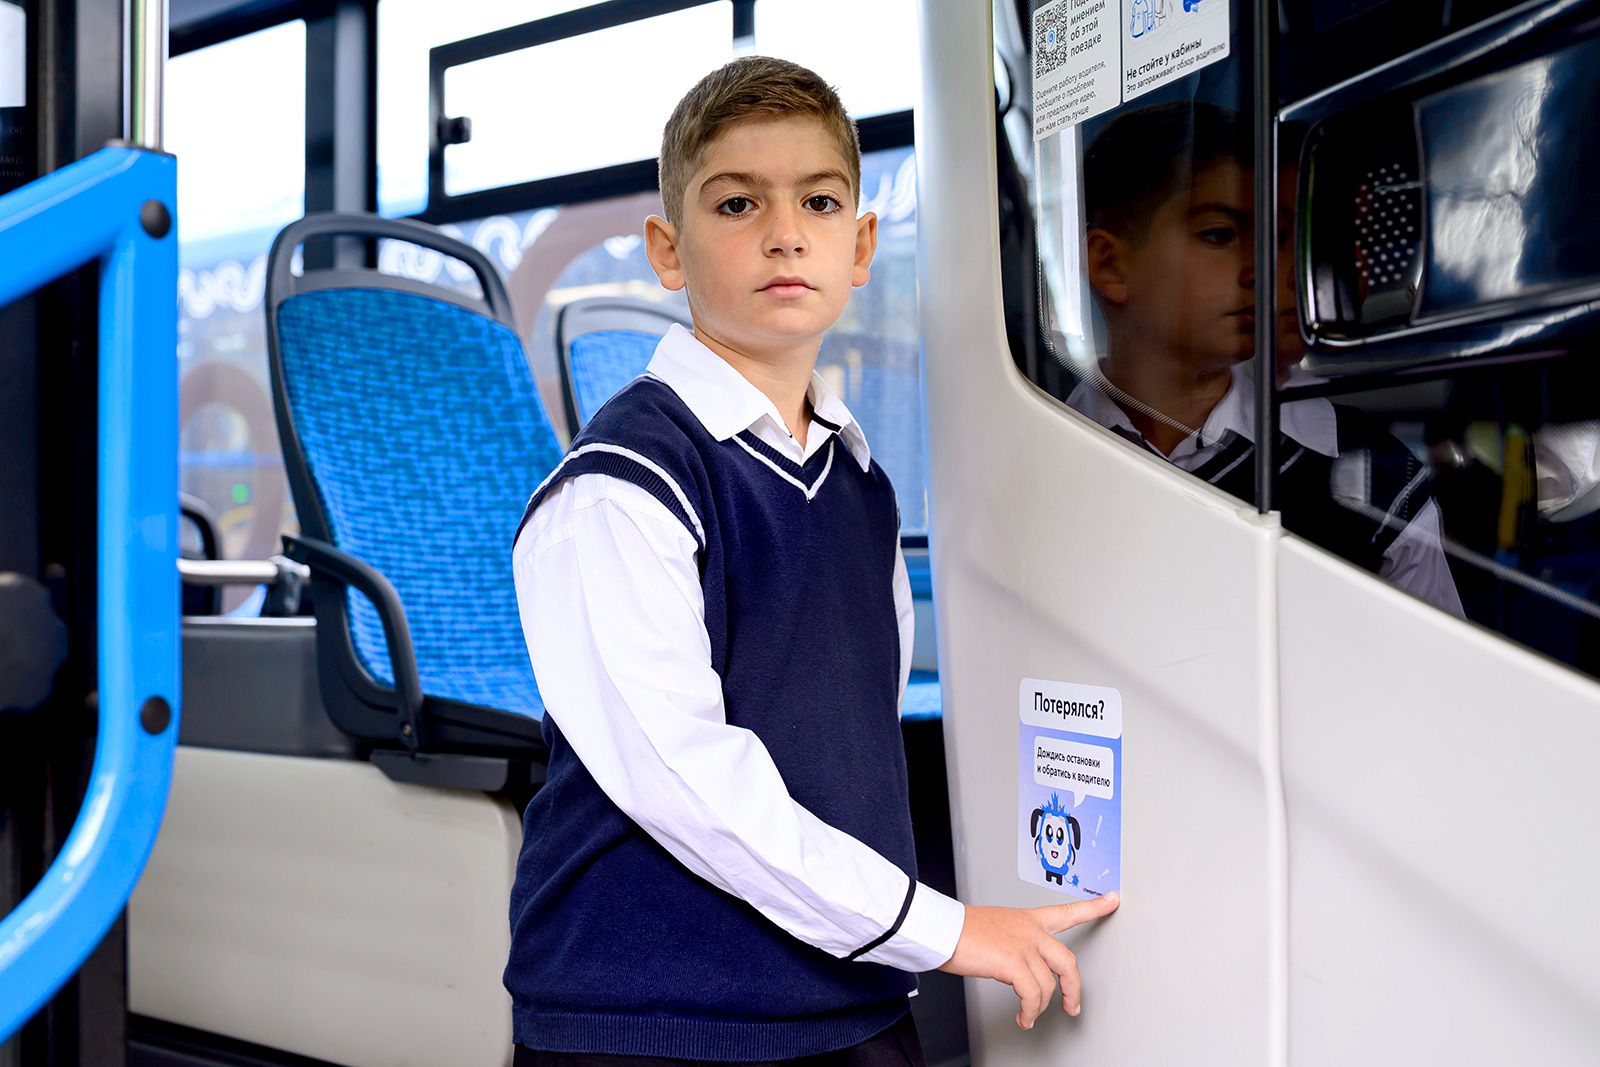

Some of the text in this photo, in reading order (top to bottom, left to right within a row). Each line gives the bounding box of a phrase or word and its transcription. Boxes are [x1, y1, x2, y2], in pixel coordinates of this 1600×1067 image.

[1071, 0, 1088, 10] Под
[1071, 1, 1105, 26] мнением
[1071, 17, 1098, 41] об этой
[1071, 34, 1101, 56] поездке
[1127, 38, 1201, 81] Не стойте у кабины
[1127, 43, 1225, 93] Это загораживает обзор водителю
[1036, 61, 1105, 100] Оцените работу водителя,
[1036, 95, 1061, 111] сообщите
[1067, 79, 1094, 97] проблеме
[1036, 91, 1096, 124] или предложите идею,
[1036, 106, 1089, 135] как нам стать лучше
[1035, 692, 1104, 720] Потерялся?
[1037, 747, 1100, 768] Дождись остановки
[1037, 764, 1110, 787] и обратись к водителю
